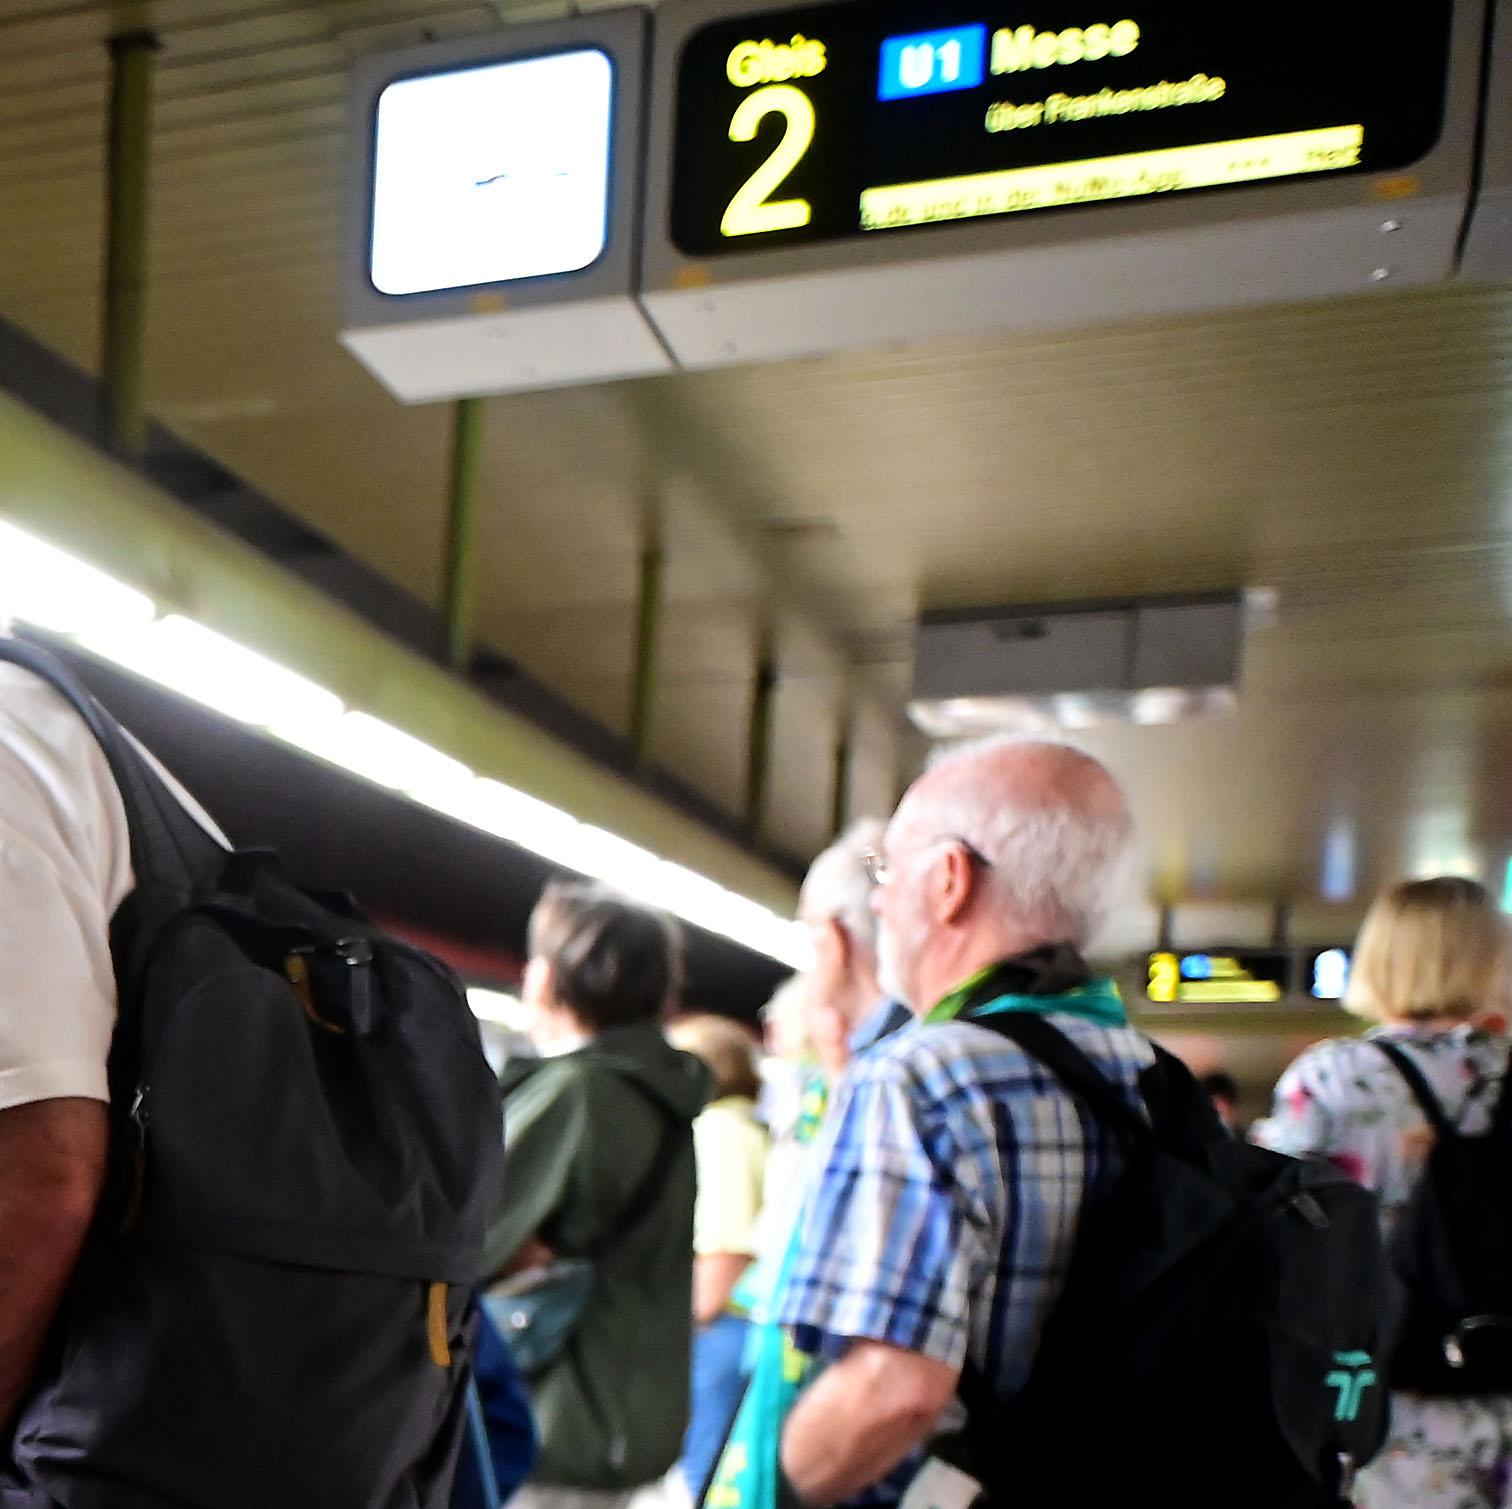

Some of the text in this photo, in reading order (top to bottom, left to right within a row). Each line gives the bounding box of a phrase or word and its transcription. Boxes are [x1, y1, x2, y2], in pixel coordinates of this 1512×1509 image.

[726, 34, 827, 87] Gleis
[898, 19, 1140, 89] U1 Messe
[720, 84, 816, 236] 2
